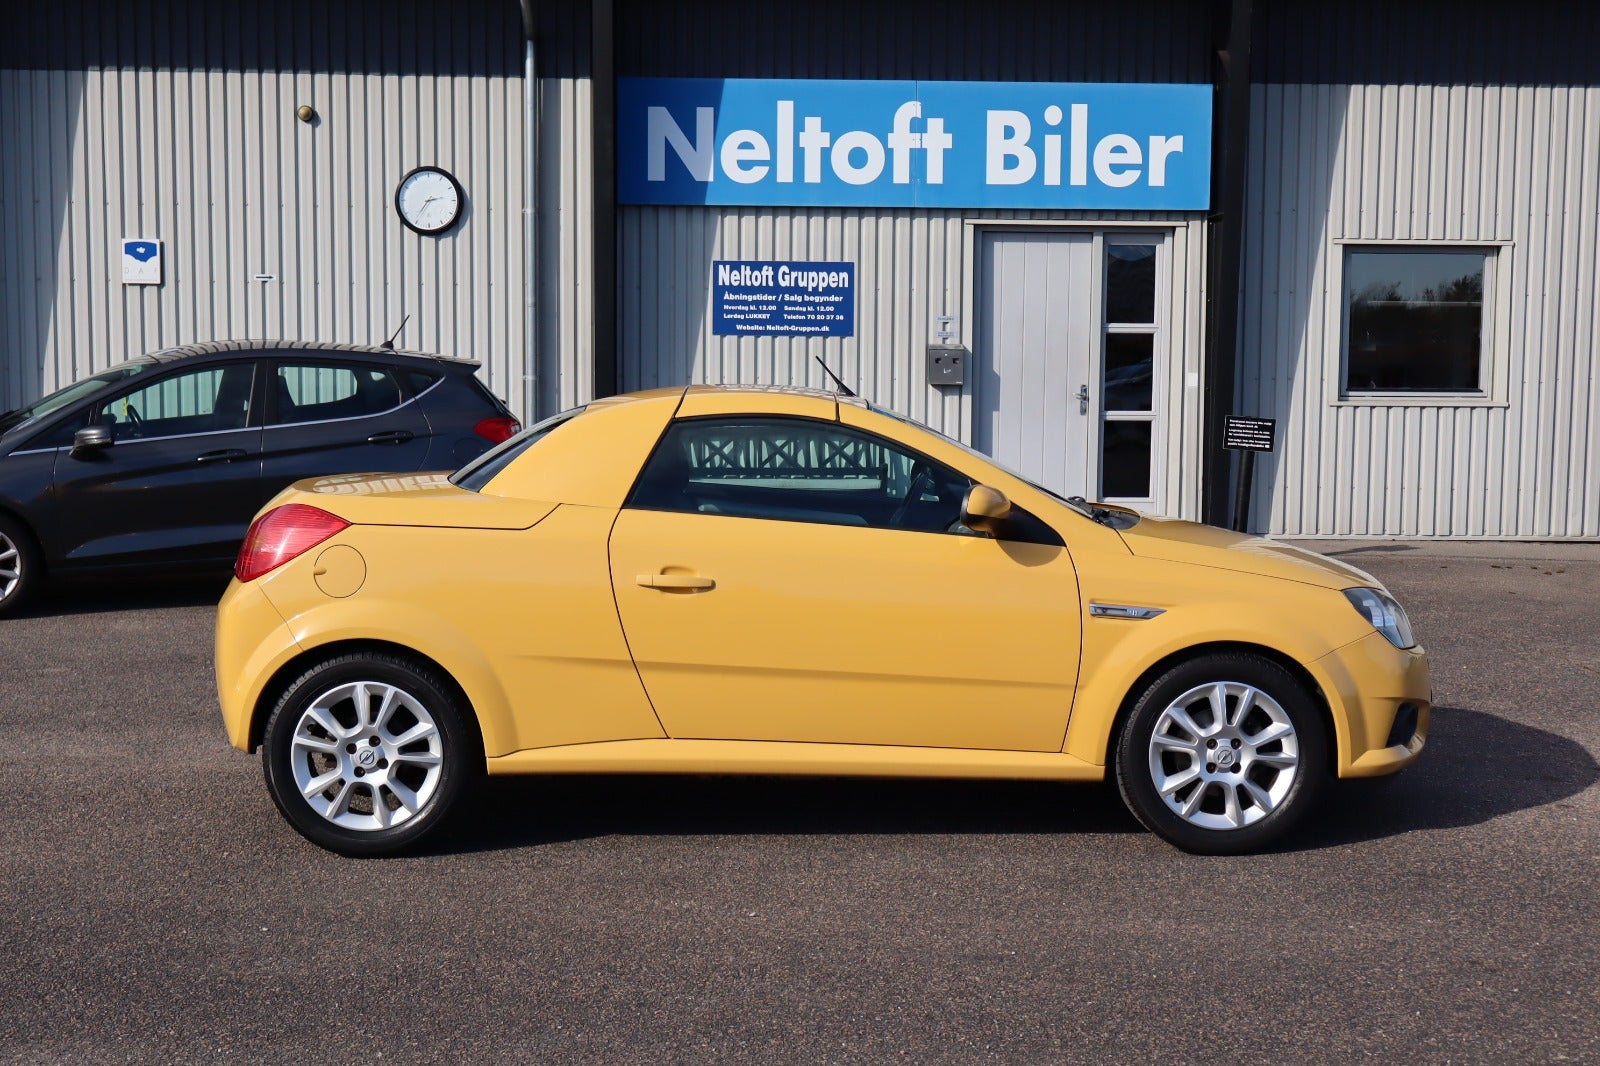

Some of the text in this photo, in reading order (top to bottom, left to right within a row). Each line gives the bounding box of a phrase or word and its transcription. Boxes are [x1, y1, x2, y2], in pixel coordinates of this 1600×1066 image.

[647, 100, 1184, 187] Neltoft Biler
[718, 264, 849, 292] Neltoft Gruppen
[723, 291, 844, 303] Åbningstider / Salg begynder
